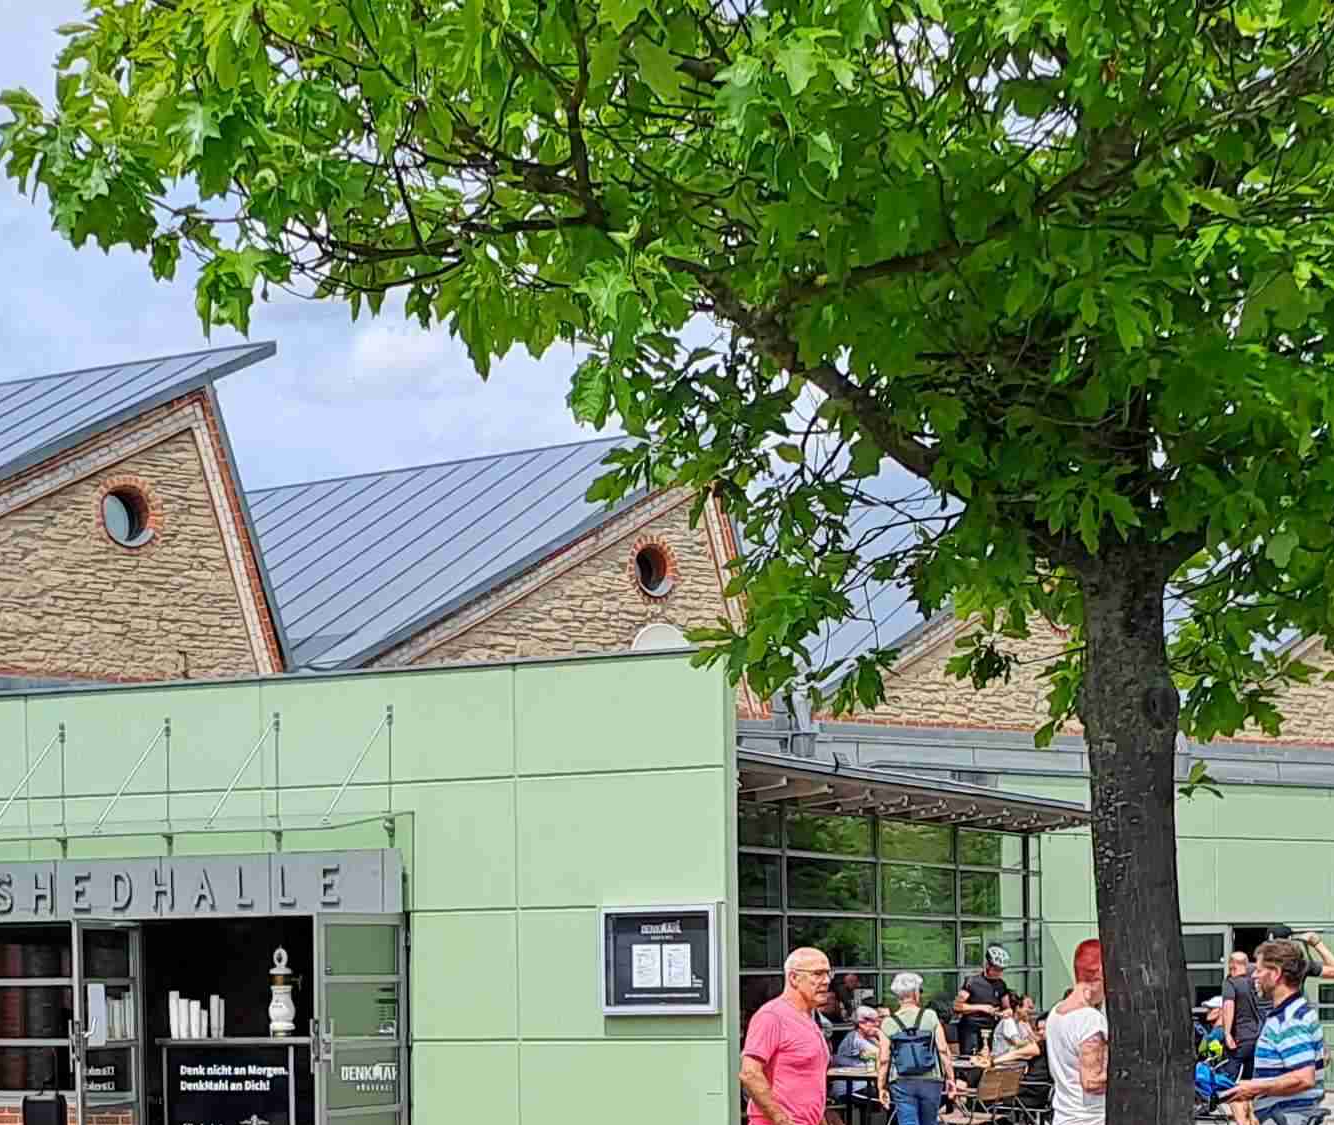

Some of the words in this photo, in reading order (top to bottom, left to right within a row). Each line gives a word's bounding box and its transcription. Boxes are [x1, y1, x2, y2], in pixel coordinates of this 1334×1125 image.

[180, 1064, 205, 1075] Denk
[207, 1064, 232, 1075] nicht
[233, 1066, 246, 1075] an
[248, 1064, 289, 1078] Morgen.
[230, 1082, 243, 1091] an
[244, 1080, 270, 1091] Dich!
